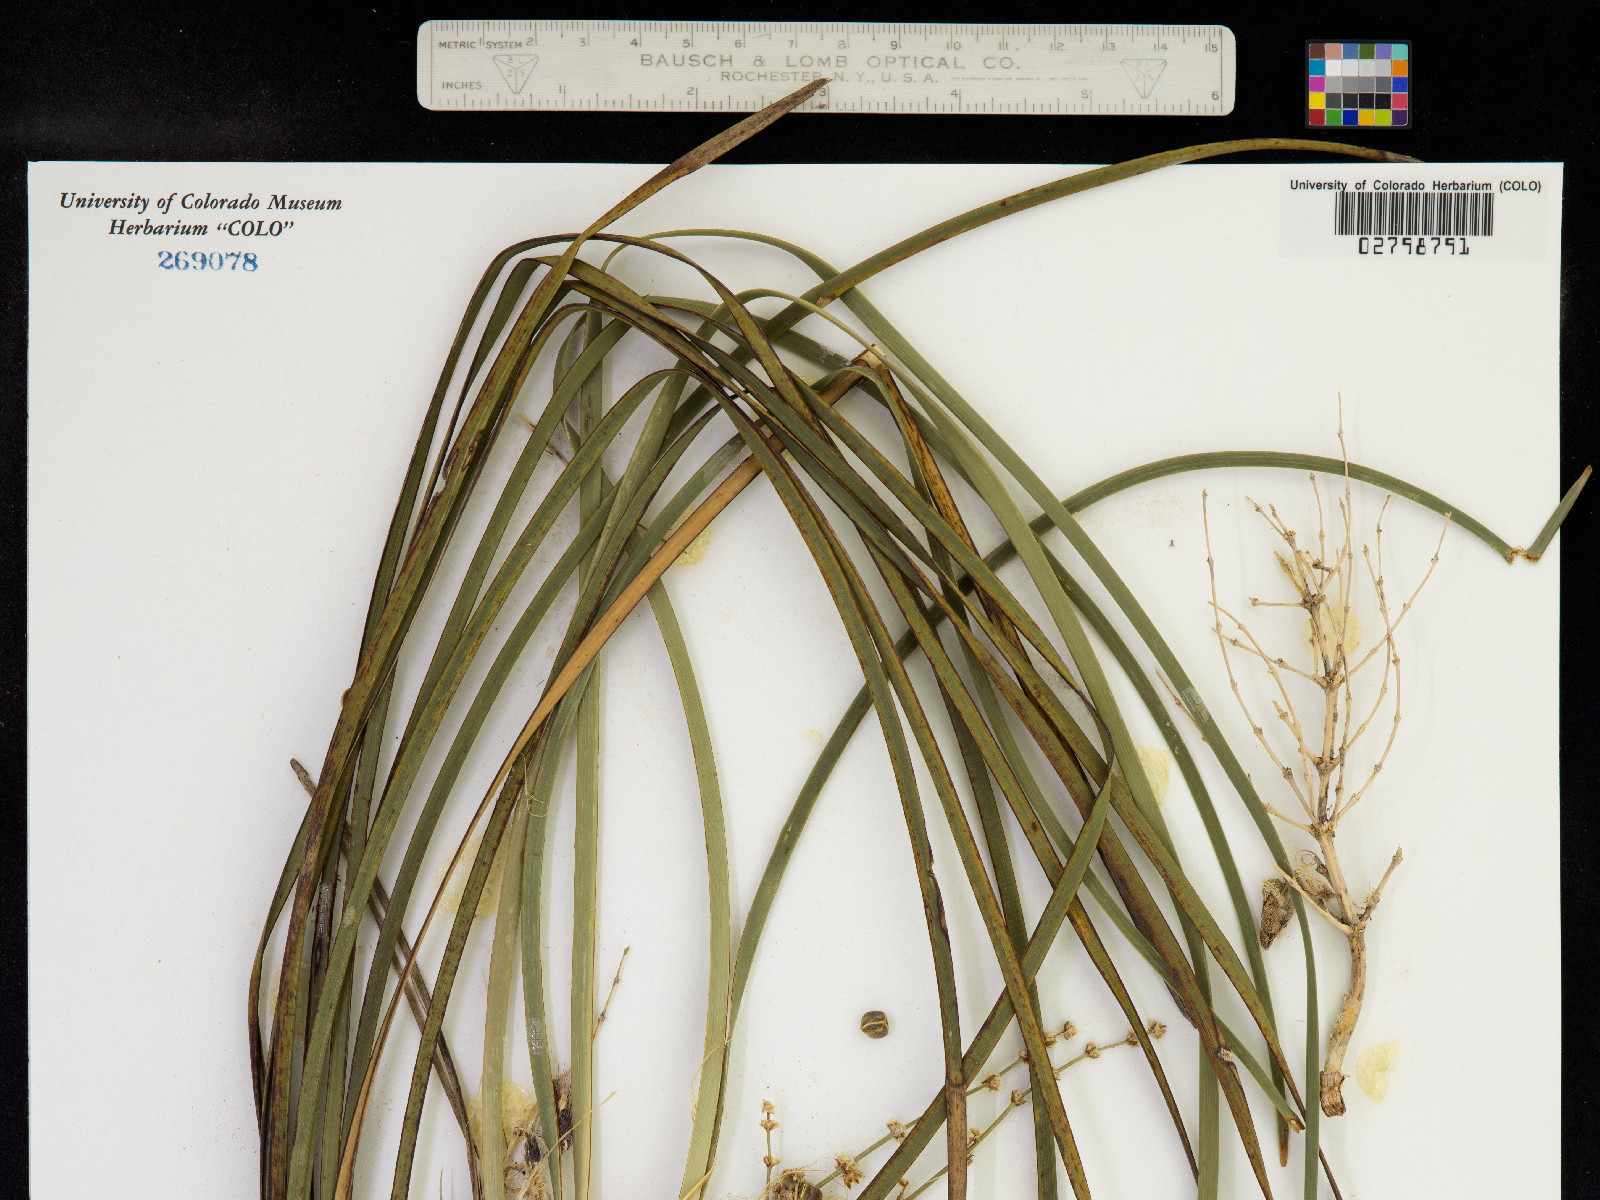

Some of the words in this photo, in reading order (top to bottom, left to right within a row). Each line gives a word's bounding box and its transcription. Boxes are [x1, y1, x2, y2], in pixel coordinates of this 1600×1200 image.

[439, 41, 476, 49] METRIC
[486, 41, 522, 49] SYSTEM
[579, 37, 586, 47] 3
[630, 38, 638, 47] 4
[682, 39, 691, 48] 5
[734, 39, 743, 49] 6
[788, 39, 794, 49] 7
[838, 39, 846, 50] 8
[890, 40, 898, 50] 9
[640, 53, 733, 67] BAUSCH
[753, 55, 766, 67] &
[786, 55, 848, 67] LOMB
[866, 55, 966, 70] OPTICAL
[983, 56, 1021, 70] CO.
[923, 73, 938, 83] A.
[442, 81, 483, 90] INCHES
[950, 89, 958, 98] 4
[1211, 91, 1219, 101] 6
[1291, 180, 1347, 191] University
[1355, 180, 1366, 190] of
[1374, 180, 1425, 190] Colorado
[1433, 181, 1491, 191] Herbarium
[1500, 181, 1541, 193] (COLO)
[61, 193, 149, 214] University
[157, 193, 177, 214] of
[181, 193, 259, 209] Colorado
[267, 195, 342, 210] Museum
[109, 219, 208, 235] Herbarium
[217, 220, 294, 236] “COLO”
[1359, 237, 1469, 255] 02798791
[158, 251, 258, 272] 269078
